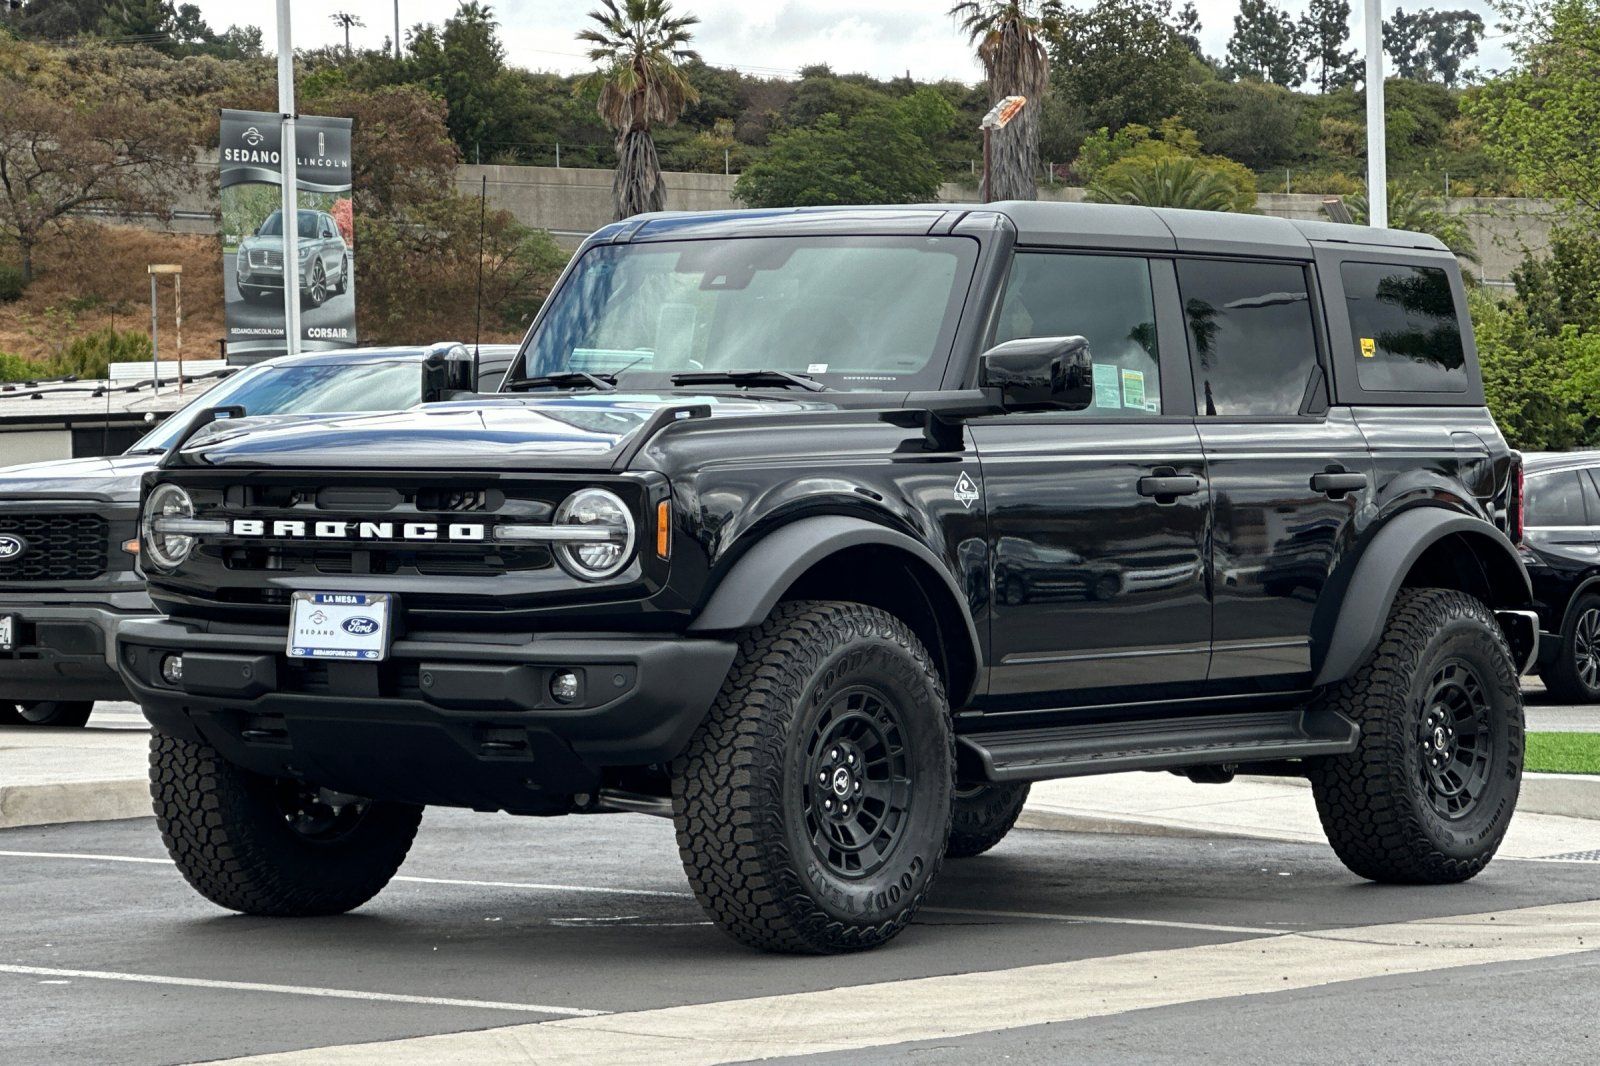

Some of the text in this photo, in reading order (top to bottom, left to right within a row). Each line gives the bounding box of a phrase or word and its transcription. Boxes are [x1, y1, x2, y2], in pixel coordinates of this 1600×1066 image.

[224, 148, 280, 164] SEDANO
[297, 158, 348, 168] LINCOLN
[230, 327, 284, 335] SEDANOLINCOLN.COM
[307, 327, 348, 338] CORSAIR
[233, 519, 485, 540] BRONCO
[323, 594, 358, 604] LA MESA
[347, 618, 372, 633] Ford
